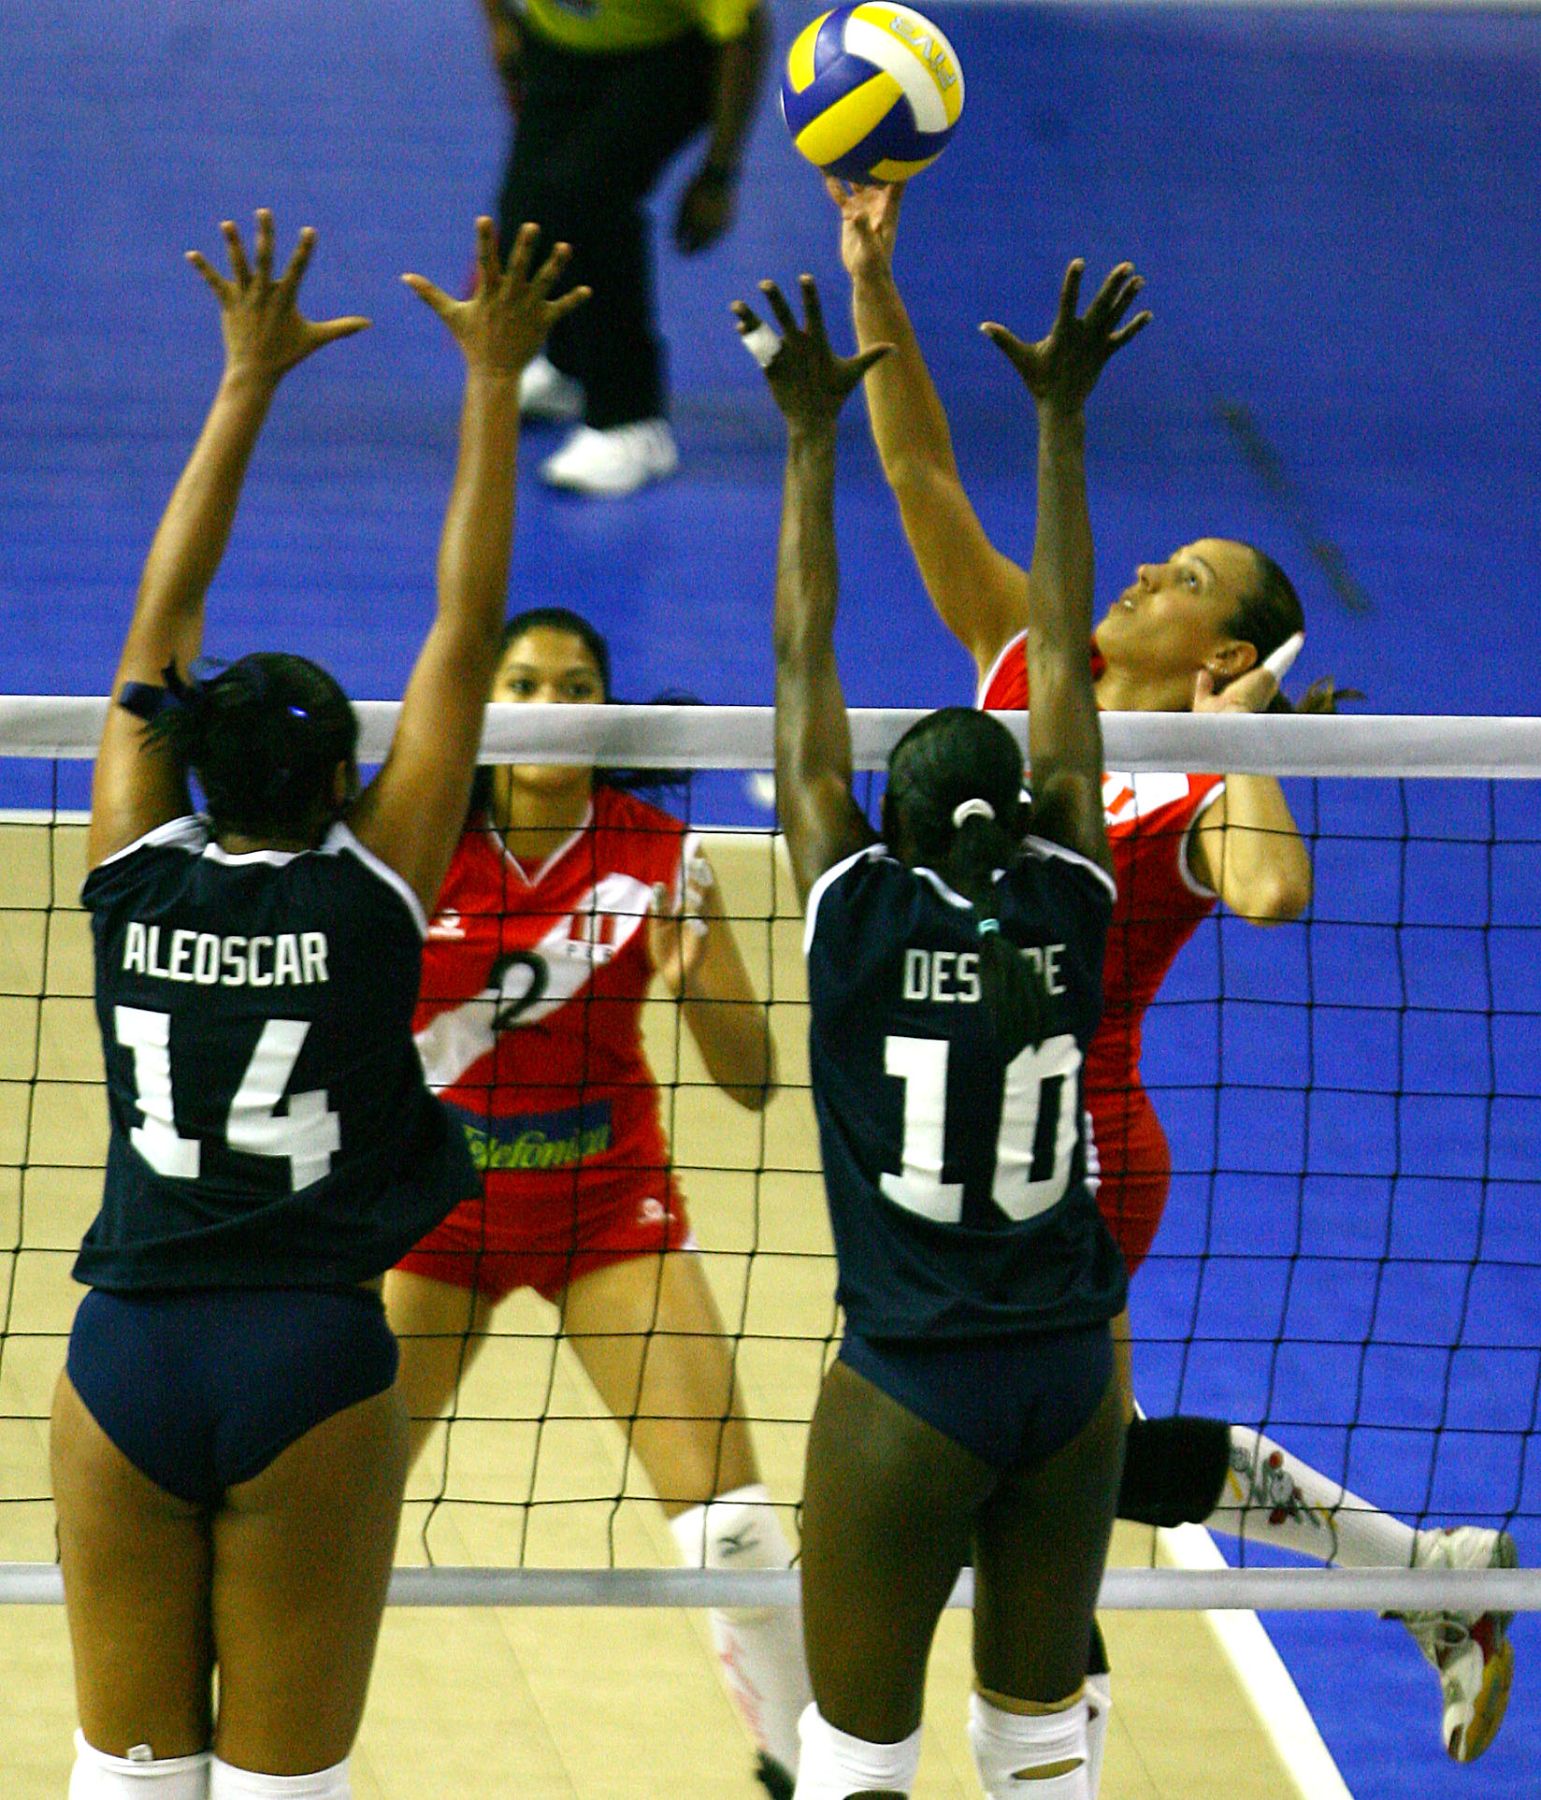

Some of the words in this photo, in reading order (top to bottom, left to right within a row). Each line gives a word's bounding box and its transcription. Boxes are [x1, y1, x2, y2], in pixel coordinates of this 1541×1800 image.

[122, 921, 329, 987] ALEOSCAR
[487, 951, 548, 1031] 2
[903, 944, 1066, 1003] DESE
[114, 1004, 341, 1192] 14
[879, 1033, 1083, 1223] 10
